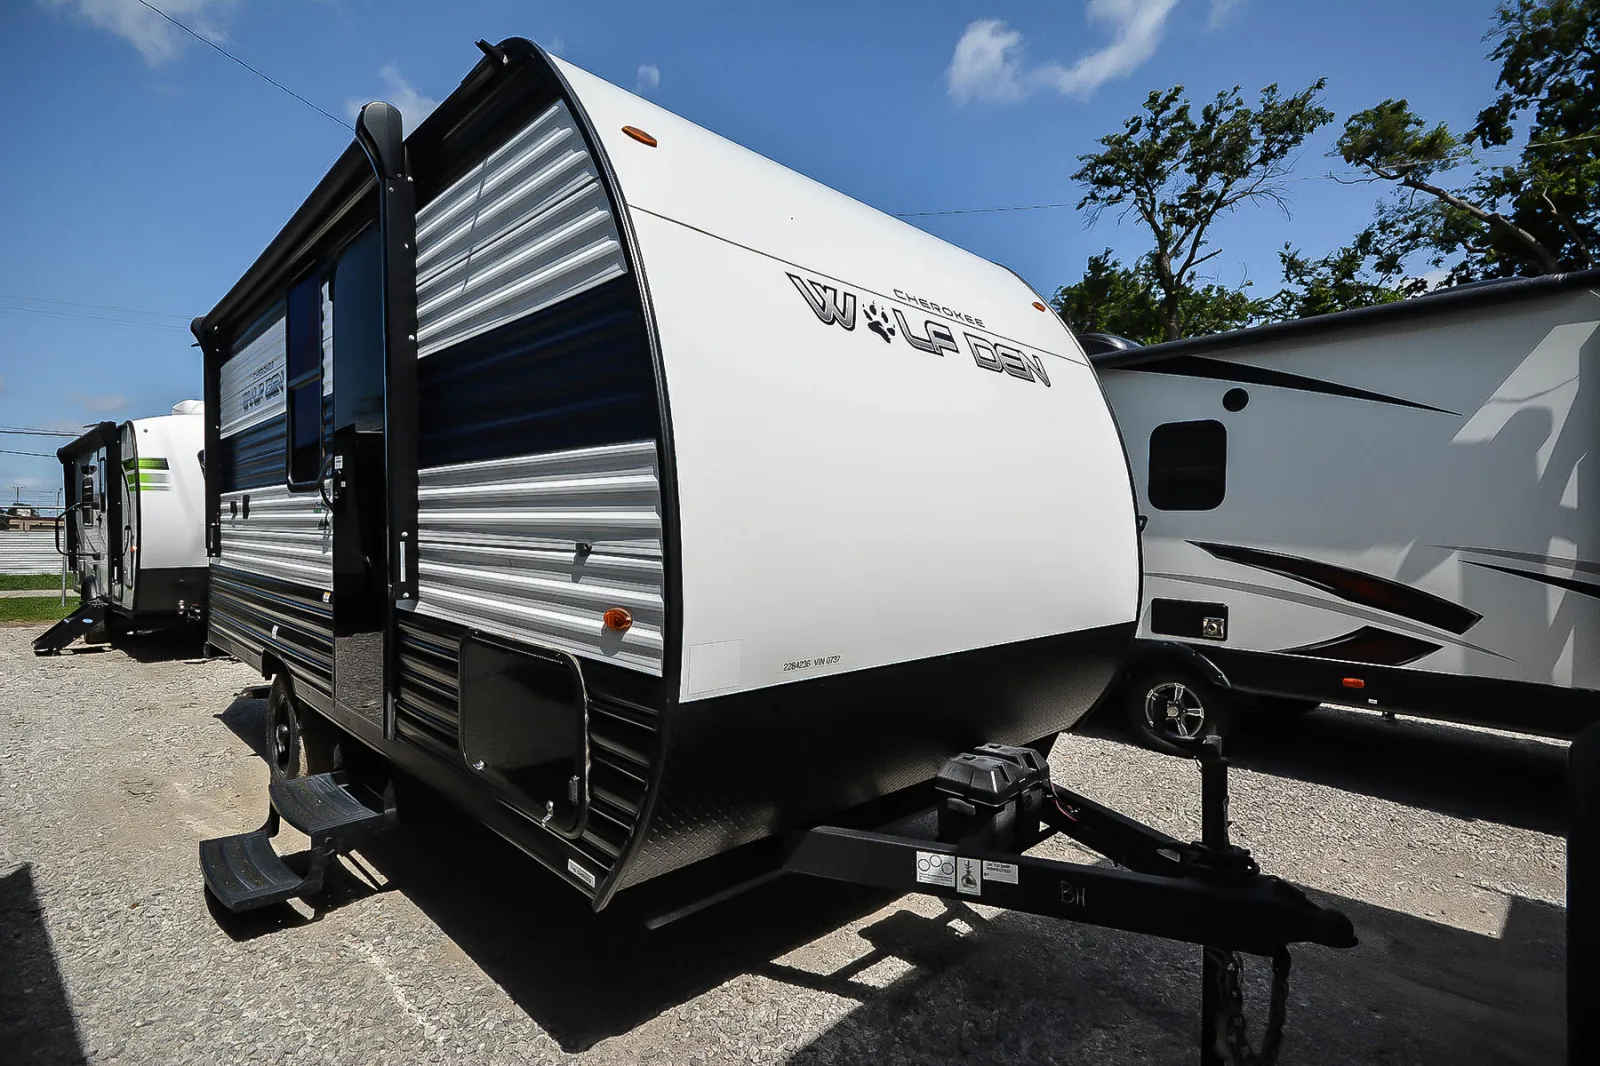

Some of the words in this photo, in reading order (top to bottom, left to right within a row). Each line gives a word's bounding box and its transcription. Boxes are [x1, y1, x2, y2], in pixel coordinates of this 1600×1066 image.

[893, 288, 986, 328] CHEROKEE
[784, 271, 960, 357] WLF
[963, 331, 1051, 388] DEN
[813, 657, 826, 667] VIN
